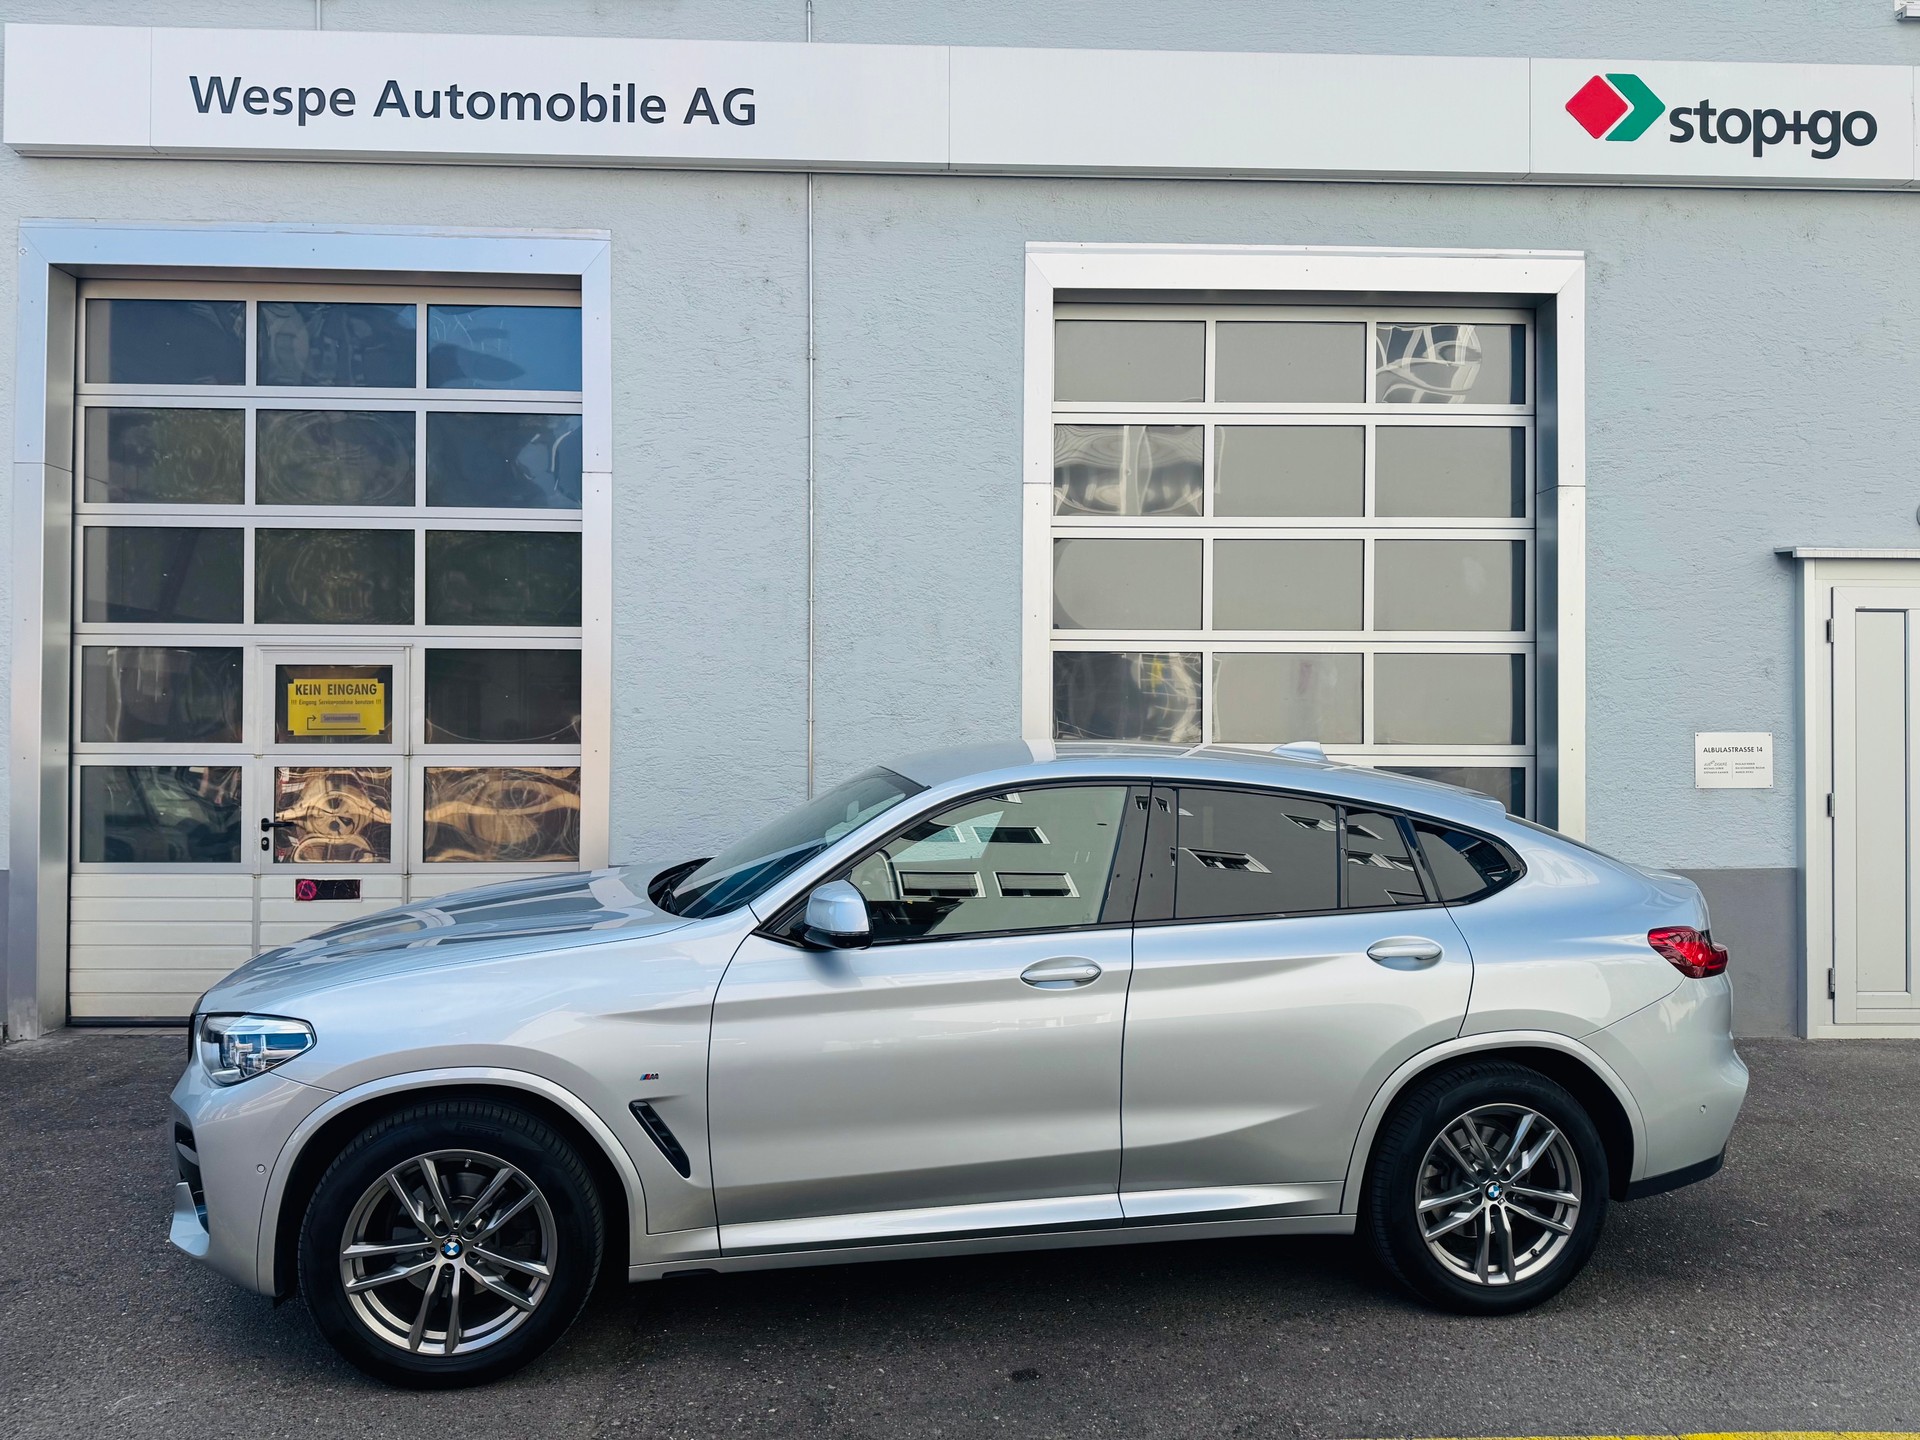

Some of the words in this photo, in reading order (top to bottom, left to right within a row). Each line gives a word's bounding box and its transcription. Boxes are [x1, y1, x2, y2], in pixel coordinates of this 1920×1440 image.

[189, 76, 356, 126] Wespe
[373, 80, 667, 124] Automobile
[683, 87, 756, 126] AG
[1669, 98, 1878, 160] stop+go
[295, 683, 321, 696] KEIN
[327, 683, 377, 695] EINGANG
